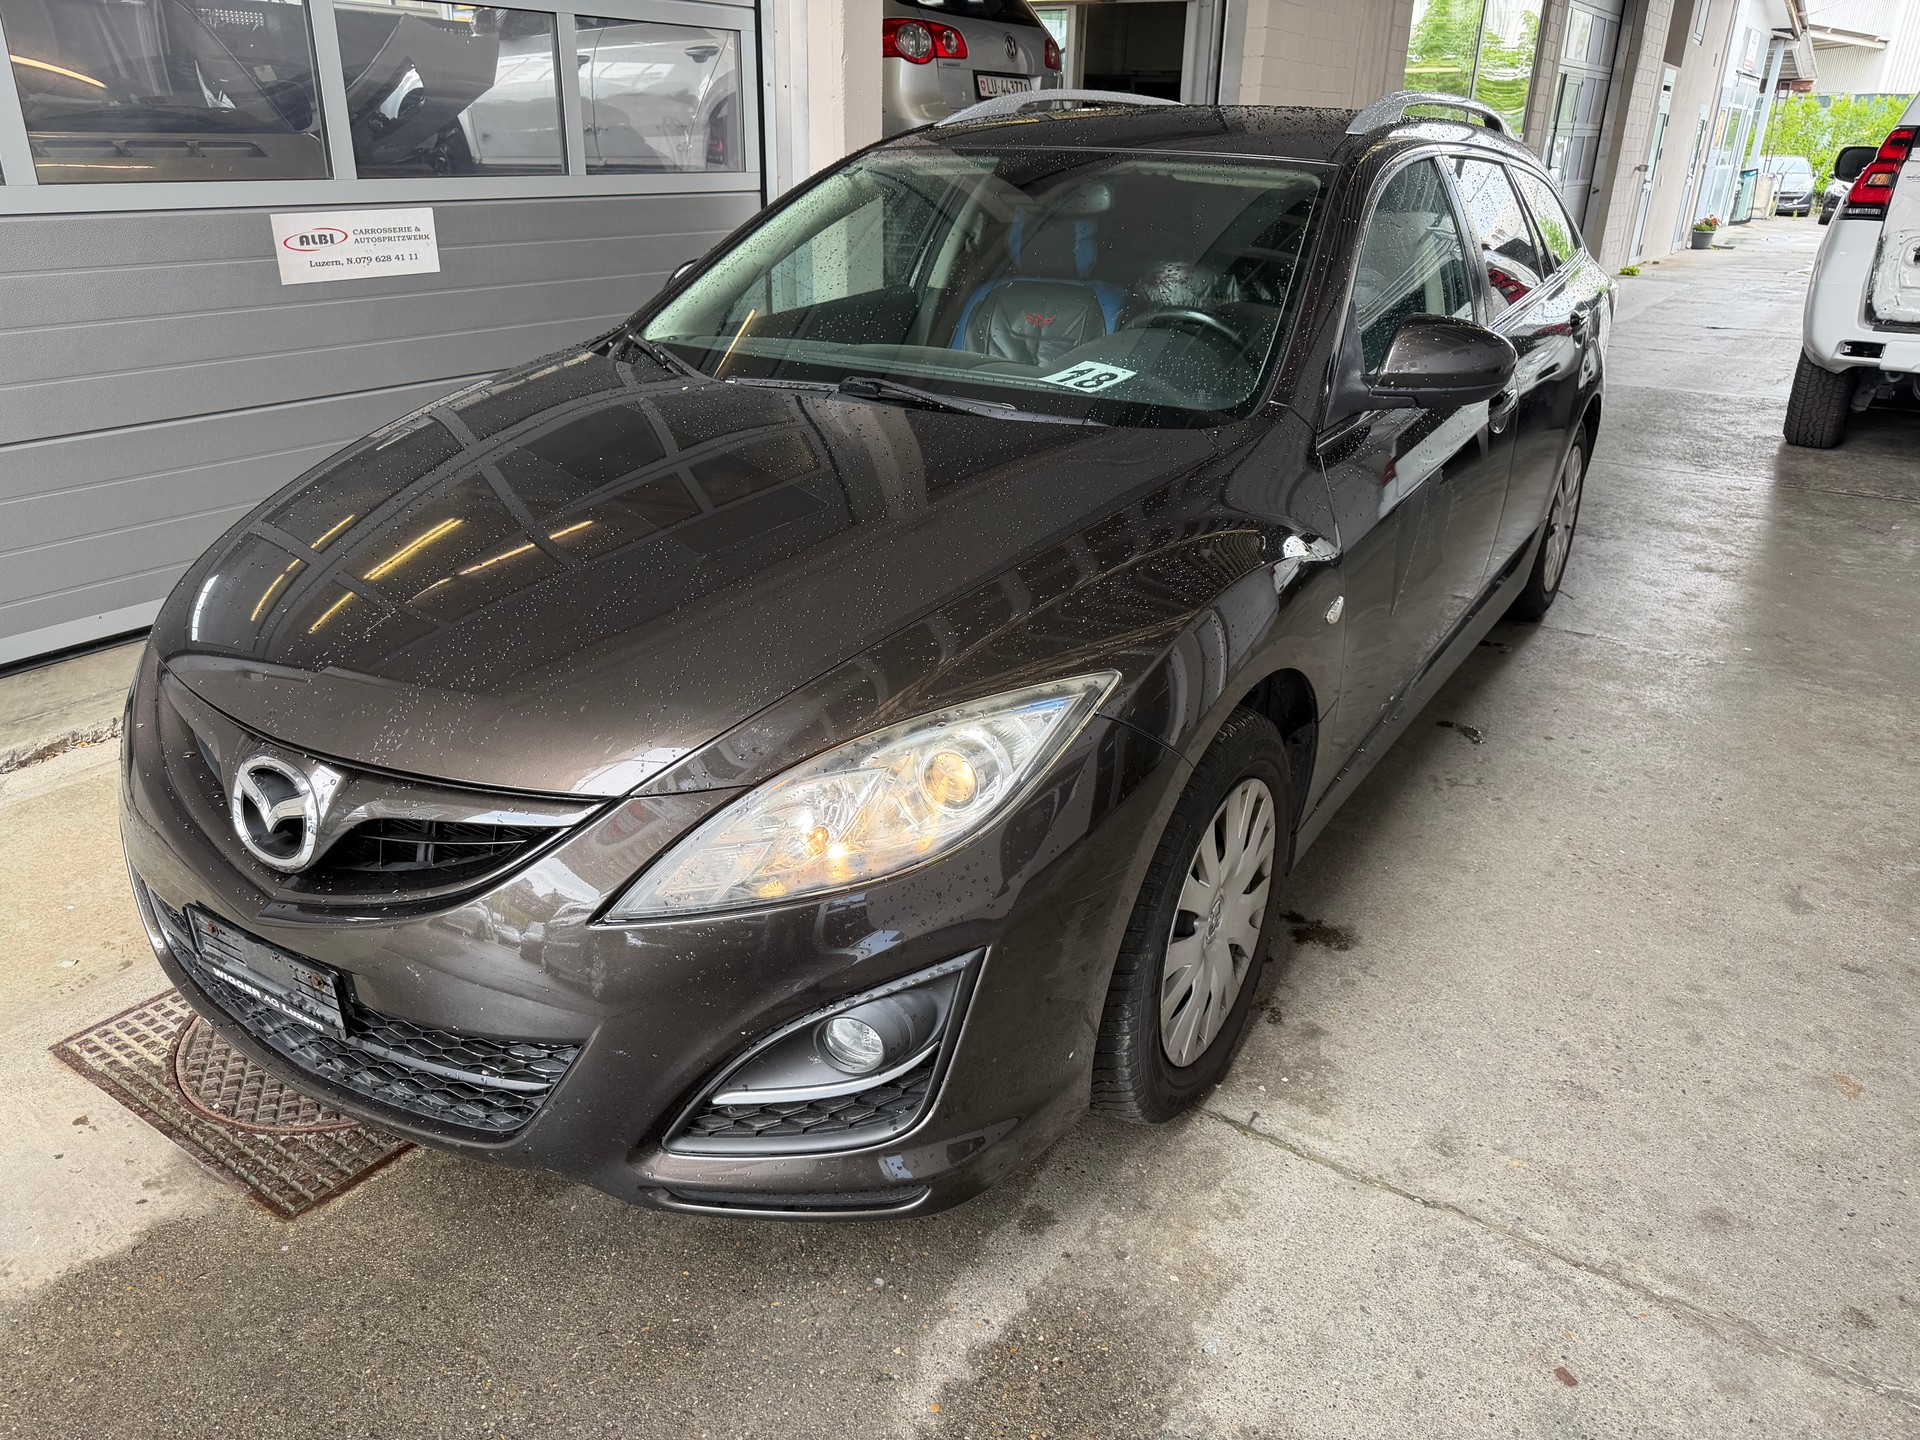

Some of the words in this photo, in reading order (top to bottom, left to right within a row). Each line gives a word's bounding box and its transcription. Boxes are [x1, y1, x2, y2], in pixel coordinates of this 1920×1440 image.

[352, 226, 412, 235] CARROSSERIE
[299, 233, 335, 246] ALBI
[354, 234, 430, 244] AUTOSPRITZWERK
[309, 259, 344, 268] Luzern,
[375, 254, 392, 263] 628
[394, 253, 406, 261] 41
[1055, 367, 1119, 388] 18
[212, 967, 262, 998] WIGGER
[281, 1003, 324, 1031] Luzern
